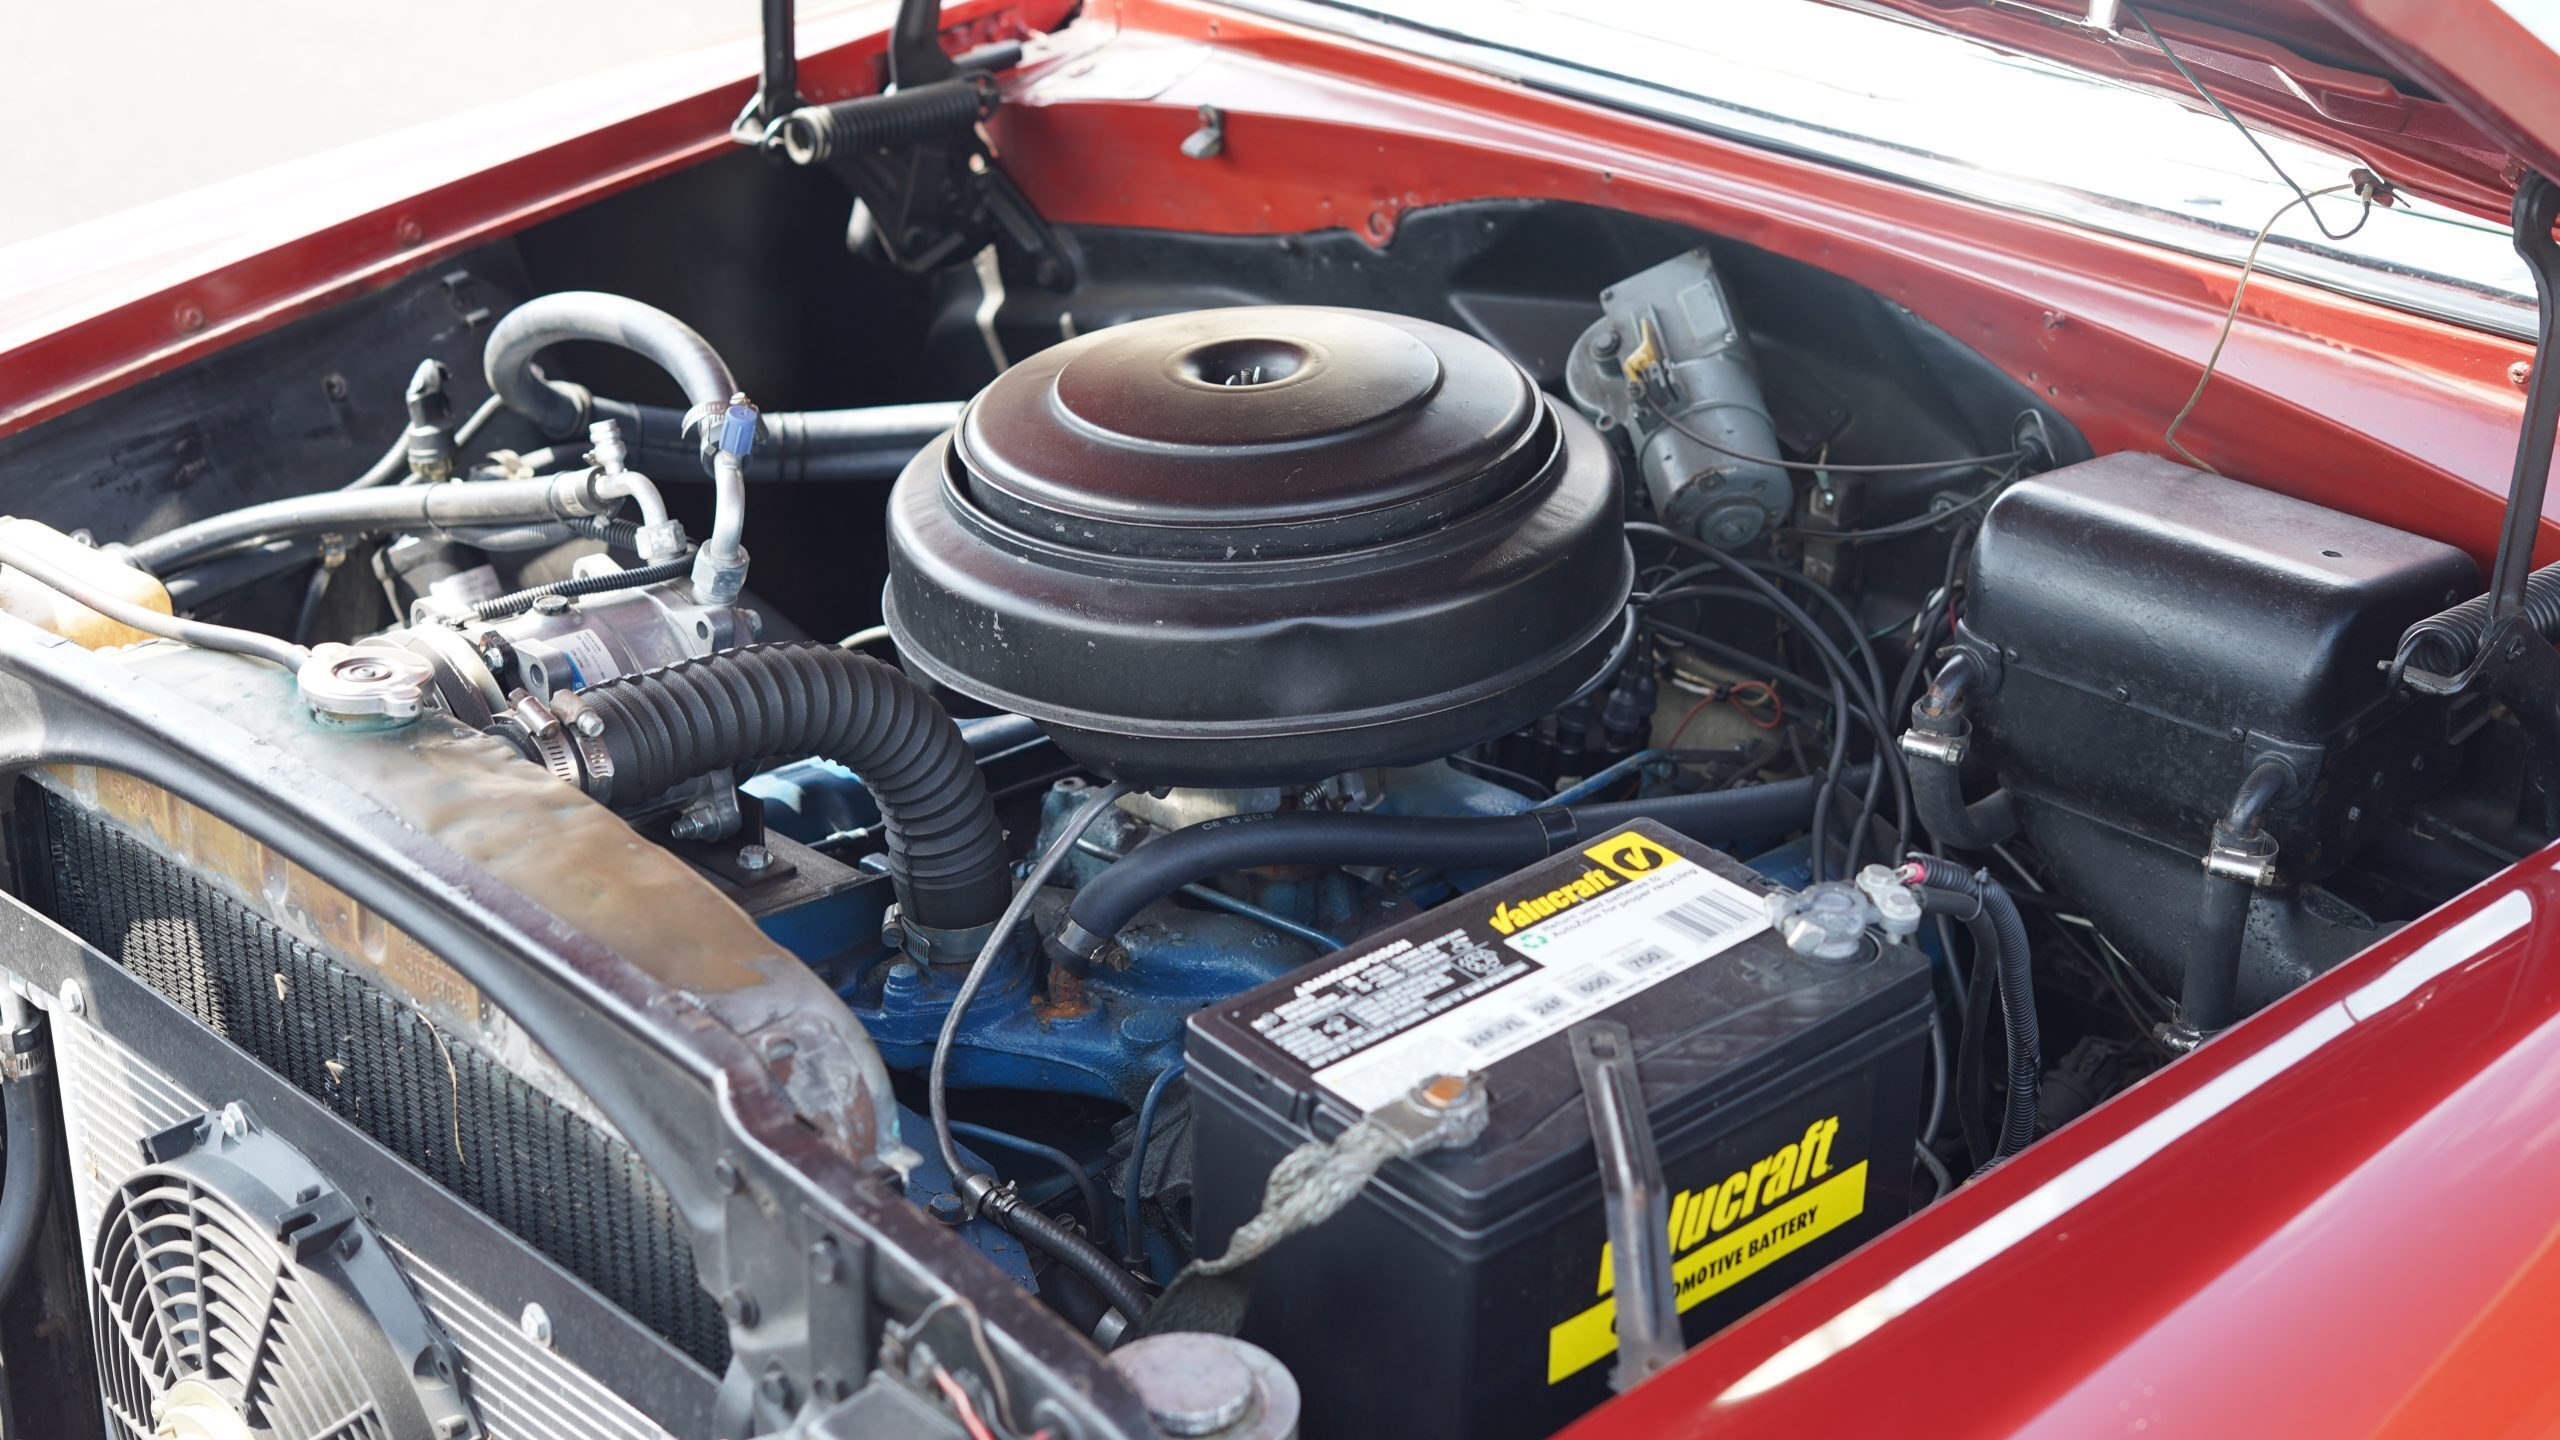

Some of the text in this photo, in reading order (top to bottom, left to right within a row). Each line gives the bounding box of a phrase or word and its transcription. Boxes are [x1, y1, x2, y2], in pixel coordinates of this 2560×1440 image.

[1488, 868, 1616, 935] Valucraft
[1553, 868, 1698, 937] AutoZone for proper recycling
[1581, 902, 1604, 915] used
[1605, 881, 1649, 903] batteries
[1580, 976, 1611, 993] 600
[1630, 952, 1661, 969] 750
[1600, 1115, 1839, 1293] lucraft
[1748, 1204, 1818, 1258] BATTERY
